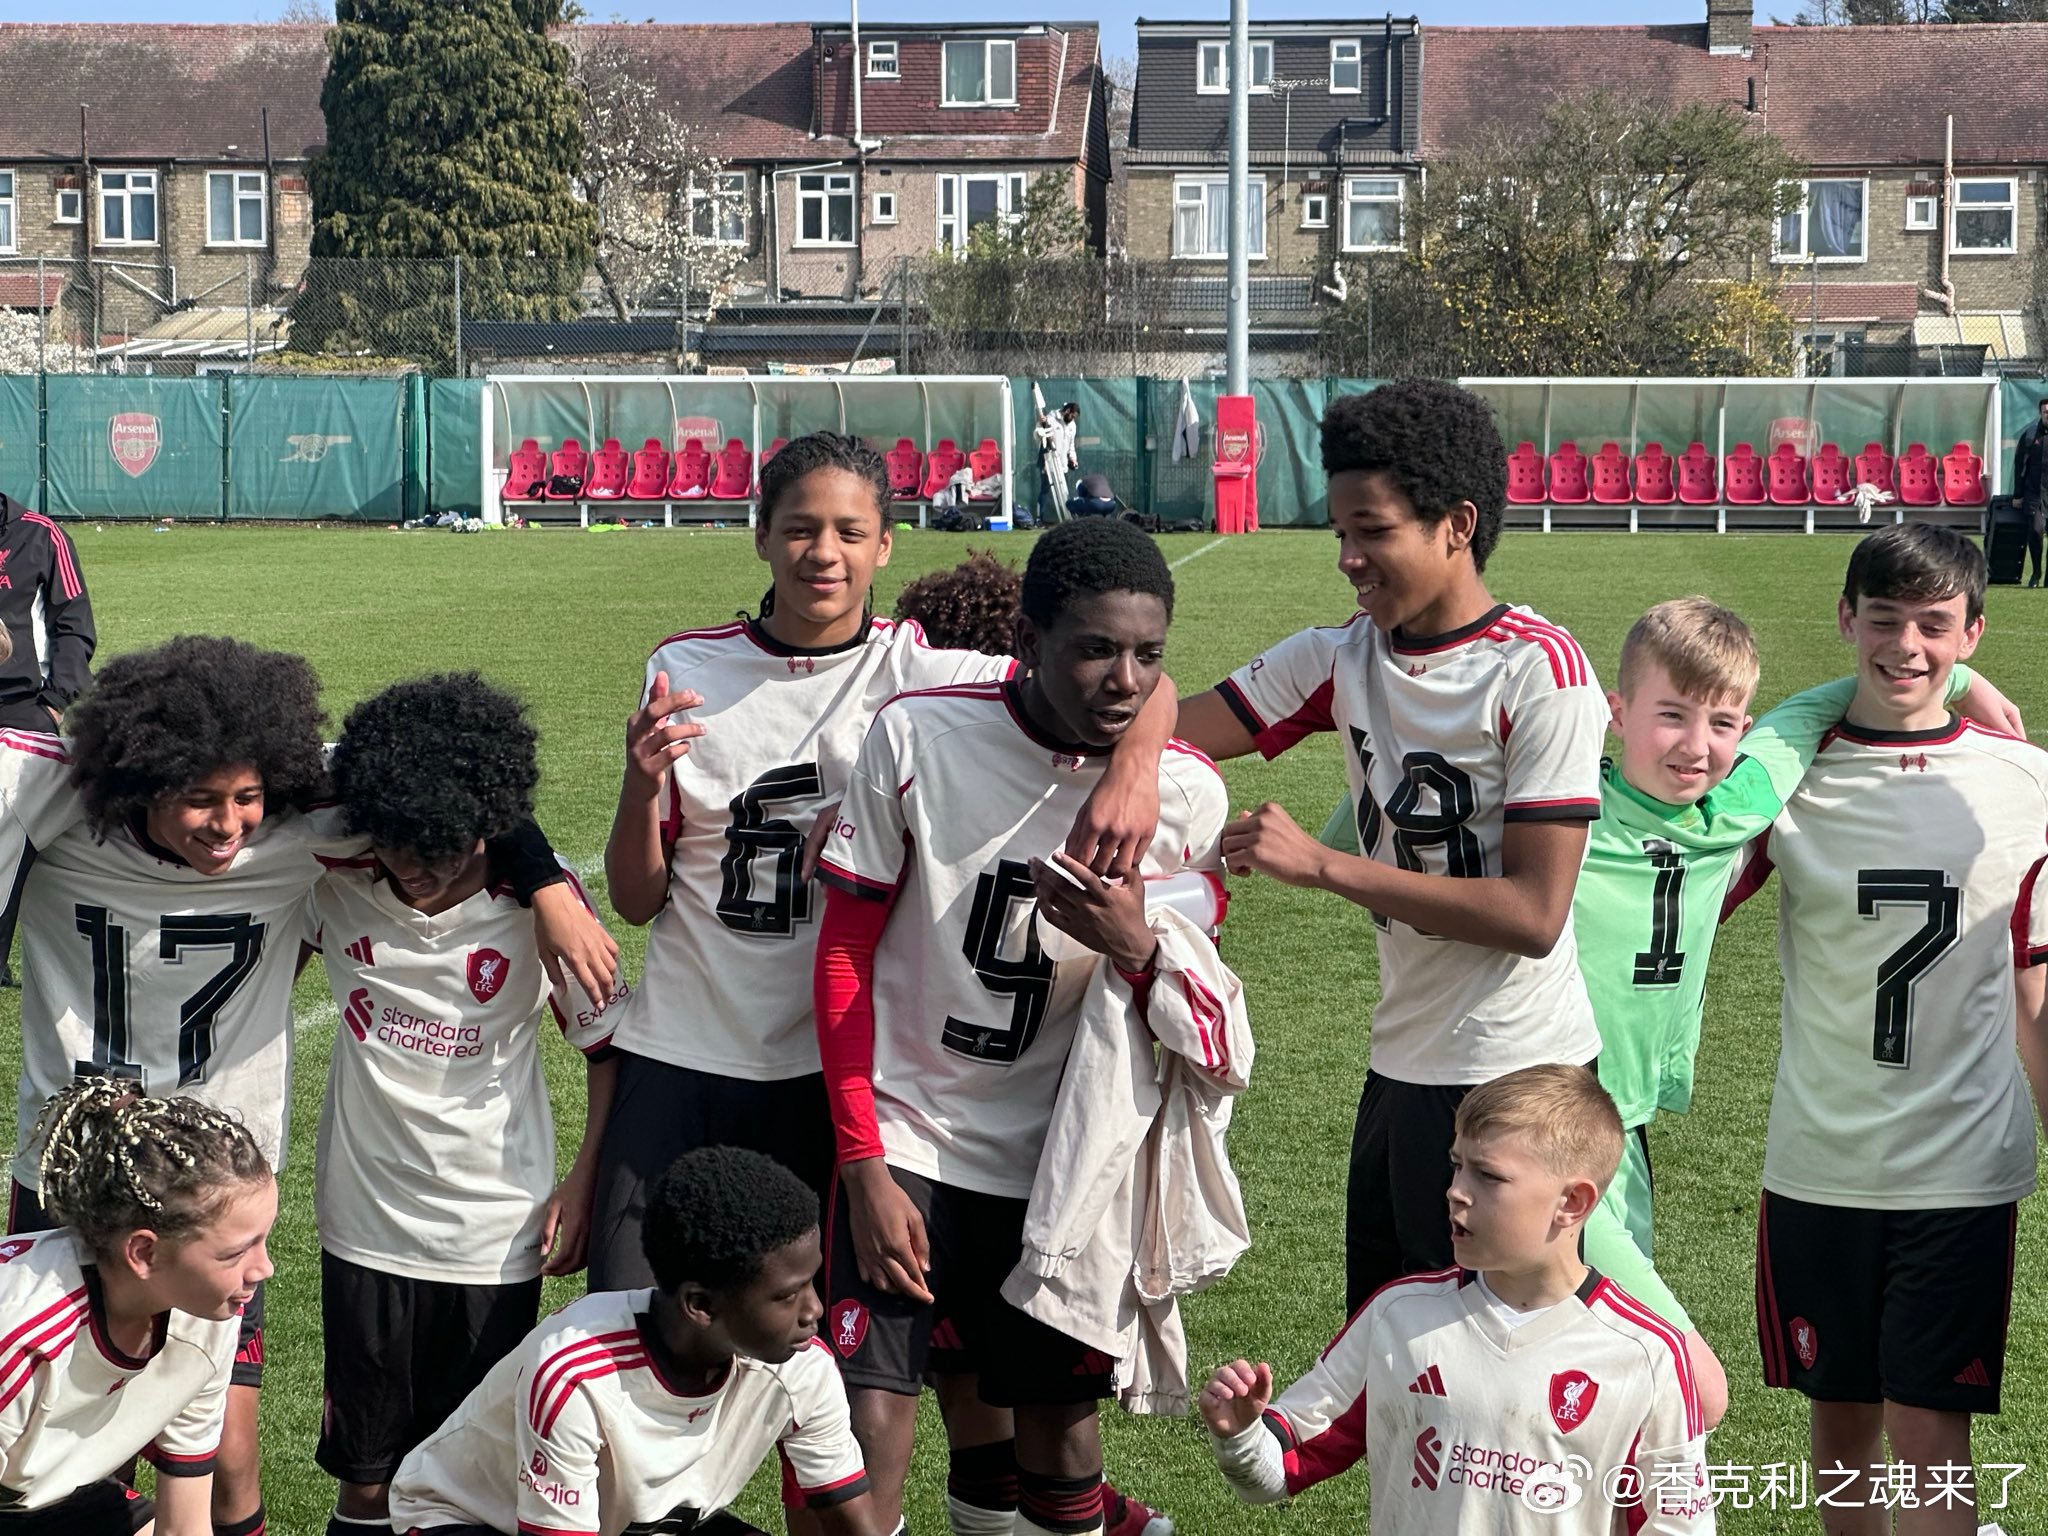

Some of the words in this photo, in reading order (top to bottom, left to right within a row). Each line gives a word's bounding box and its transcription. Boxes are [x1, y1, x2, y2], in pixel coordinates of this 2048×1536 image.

[115, 423, 155, 434] Arsenal
[678, 427, 716, 437] Arsenal
[716, 762, 826, 939] 6
[1632, 839, 1687, 990] 1
[74, 903, 268, 1090] 17
[381, 1006, 481, 1042] standard
[941, 858, 1060, 1067] 9
[1857, 869, 1965, 1070] 7
[377, 1026, 484, 1058] chartered
